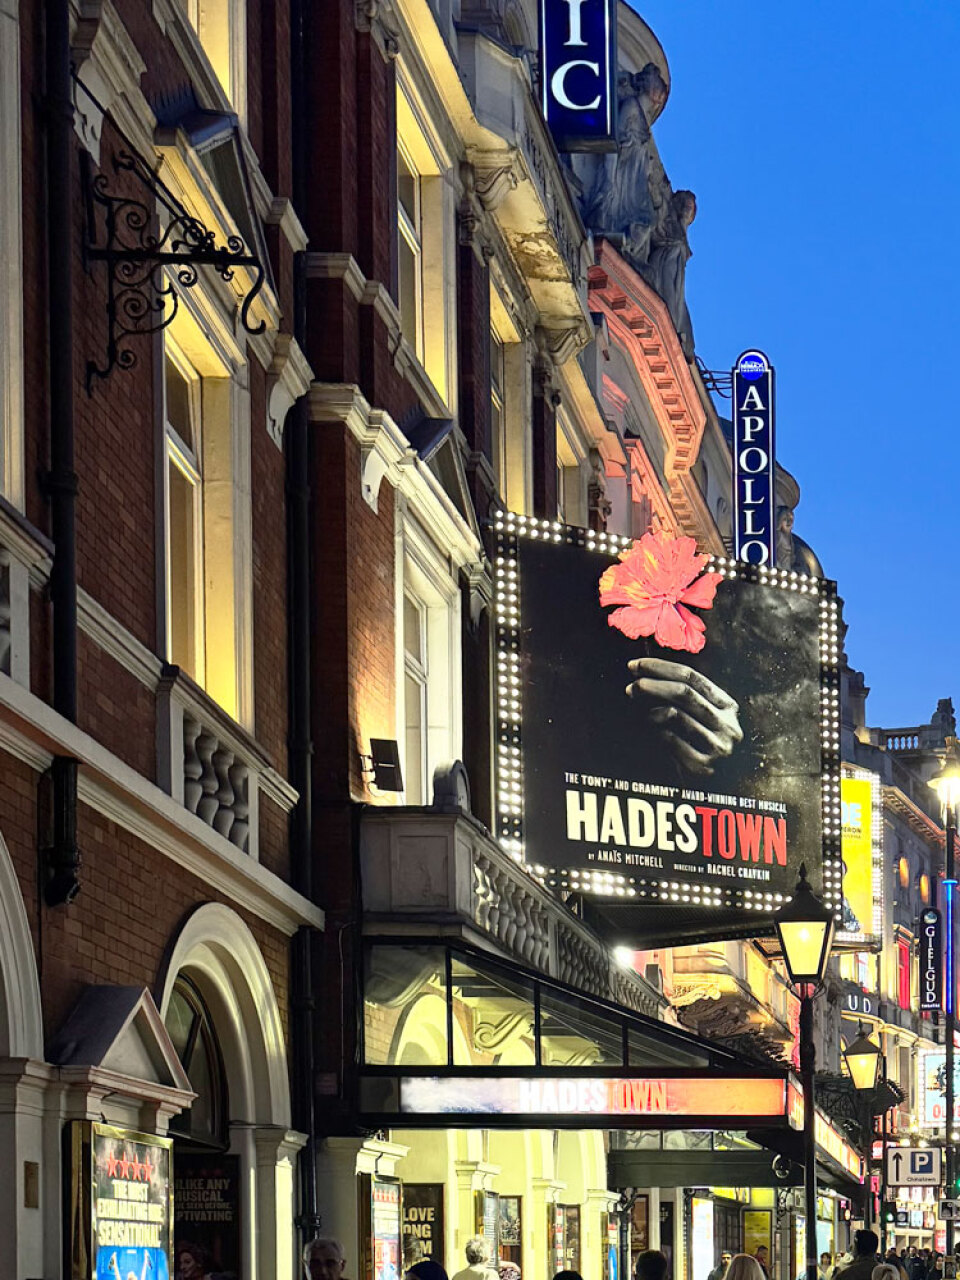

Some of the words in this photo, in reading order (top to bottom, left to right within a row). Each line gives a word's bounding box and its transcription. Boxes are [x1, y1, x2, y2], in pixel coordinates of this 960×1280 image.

[739, 385, 769, 566] APOLLO
[565, 772, 579, 784] THE
[614, 779, 629, 791] AND
[739, 796, 756, 809] BEST
[758, 799, 787, 814] MUSICAL
[625, 853, 664, 869] MITCHELL
[707, 863, 736, 878] RACHEL
[925, 926, 937, 1003] GIELGUD
[519, 1081, 668, 1113] HADESTOWN
[914, 1153, 929, 1172] P
